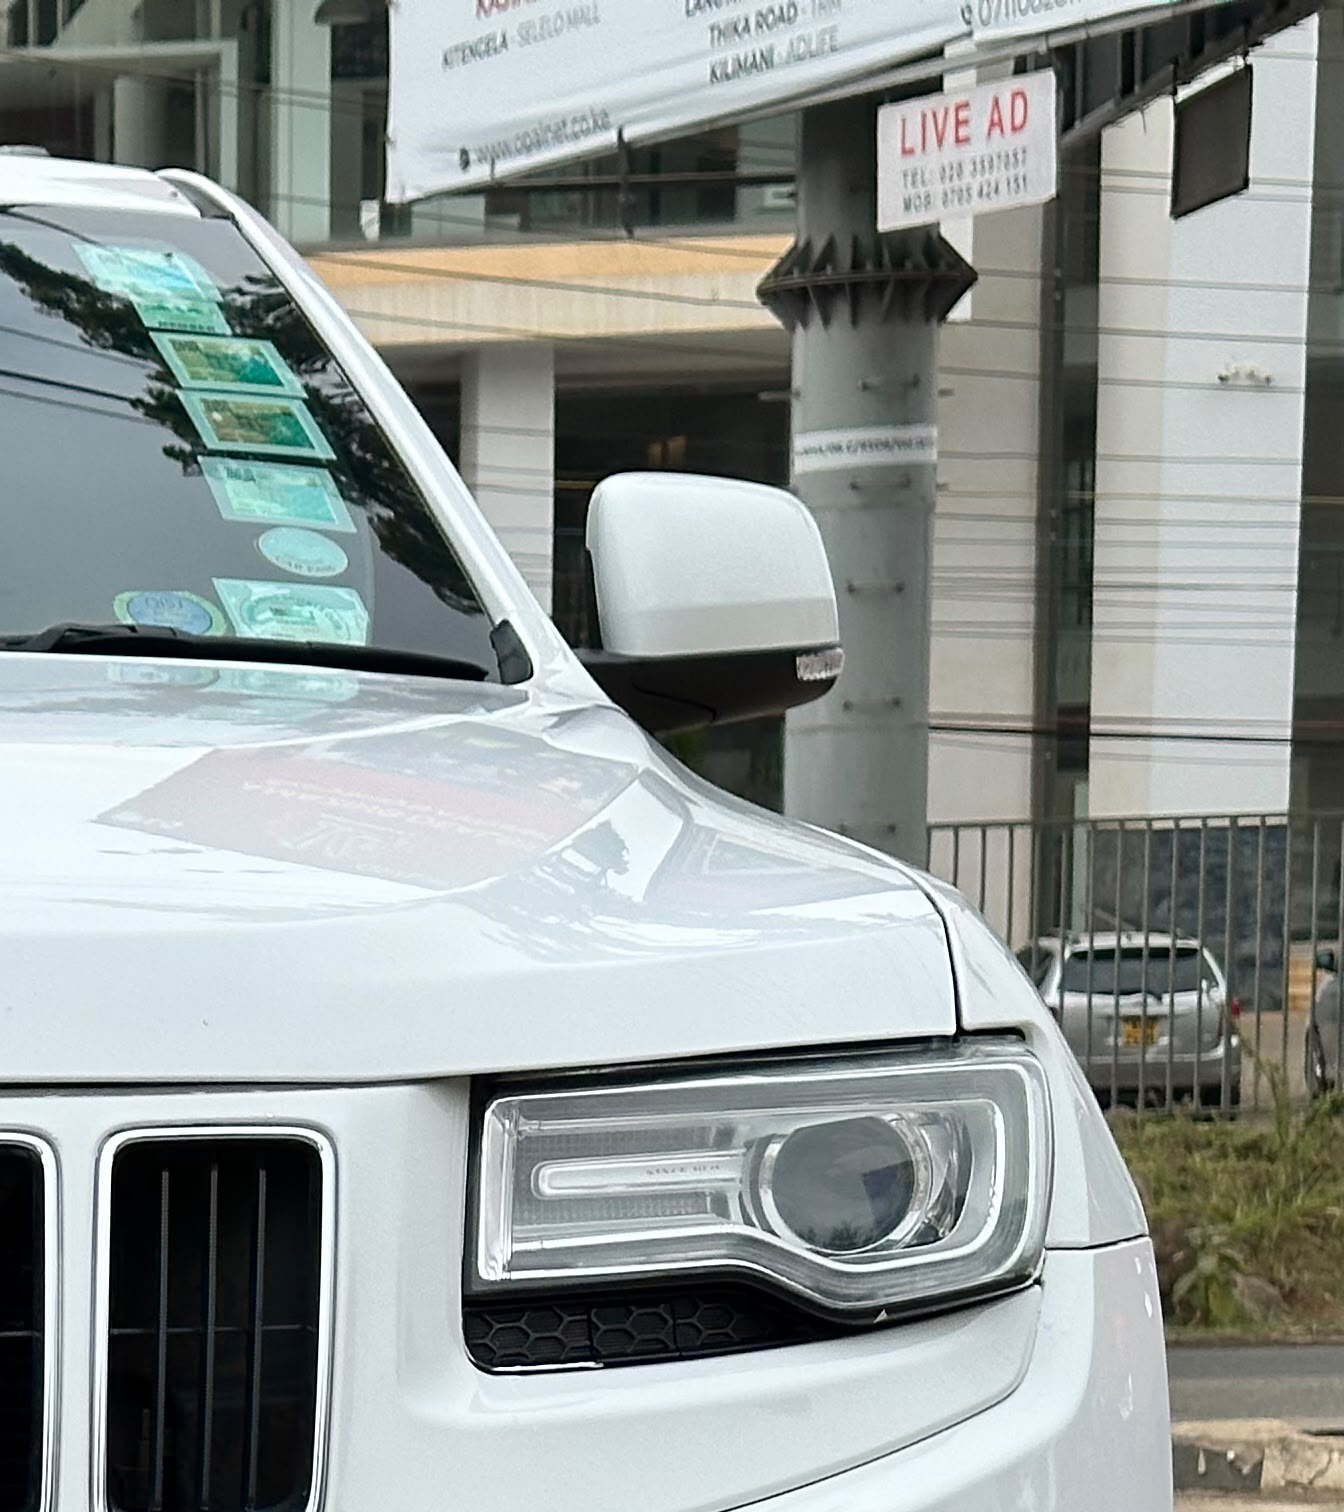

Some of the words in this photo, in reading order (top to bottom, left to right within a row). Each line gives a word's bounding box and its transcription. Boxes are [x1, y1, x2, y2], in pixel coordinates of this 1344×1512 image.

[755, 1, 798, 35] ROAD
[900, 100, 971, 158] LIVE
[986, 89, 1029, 140] AD
